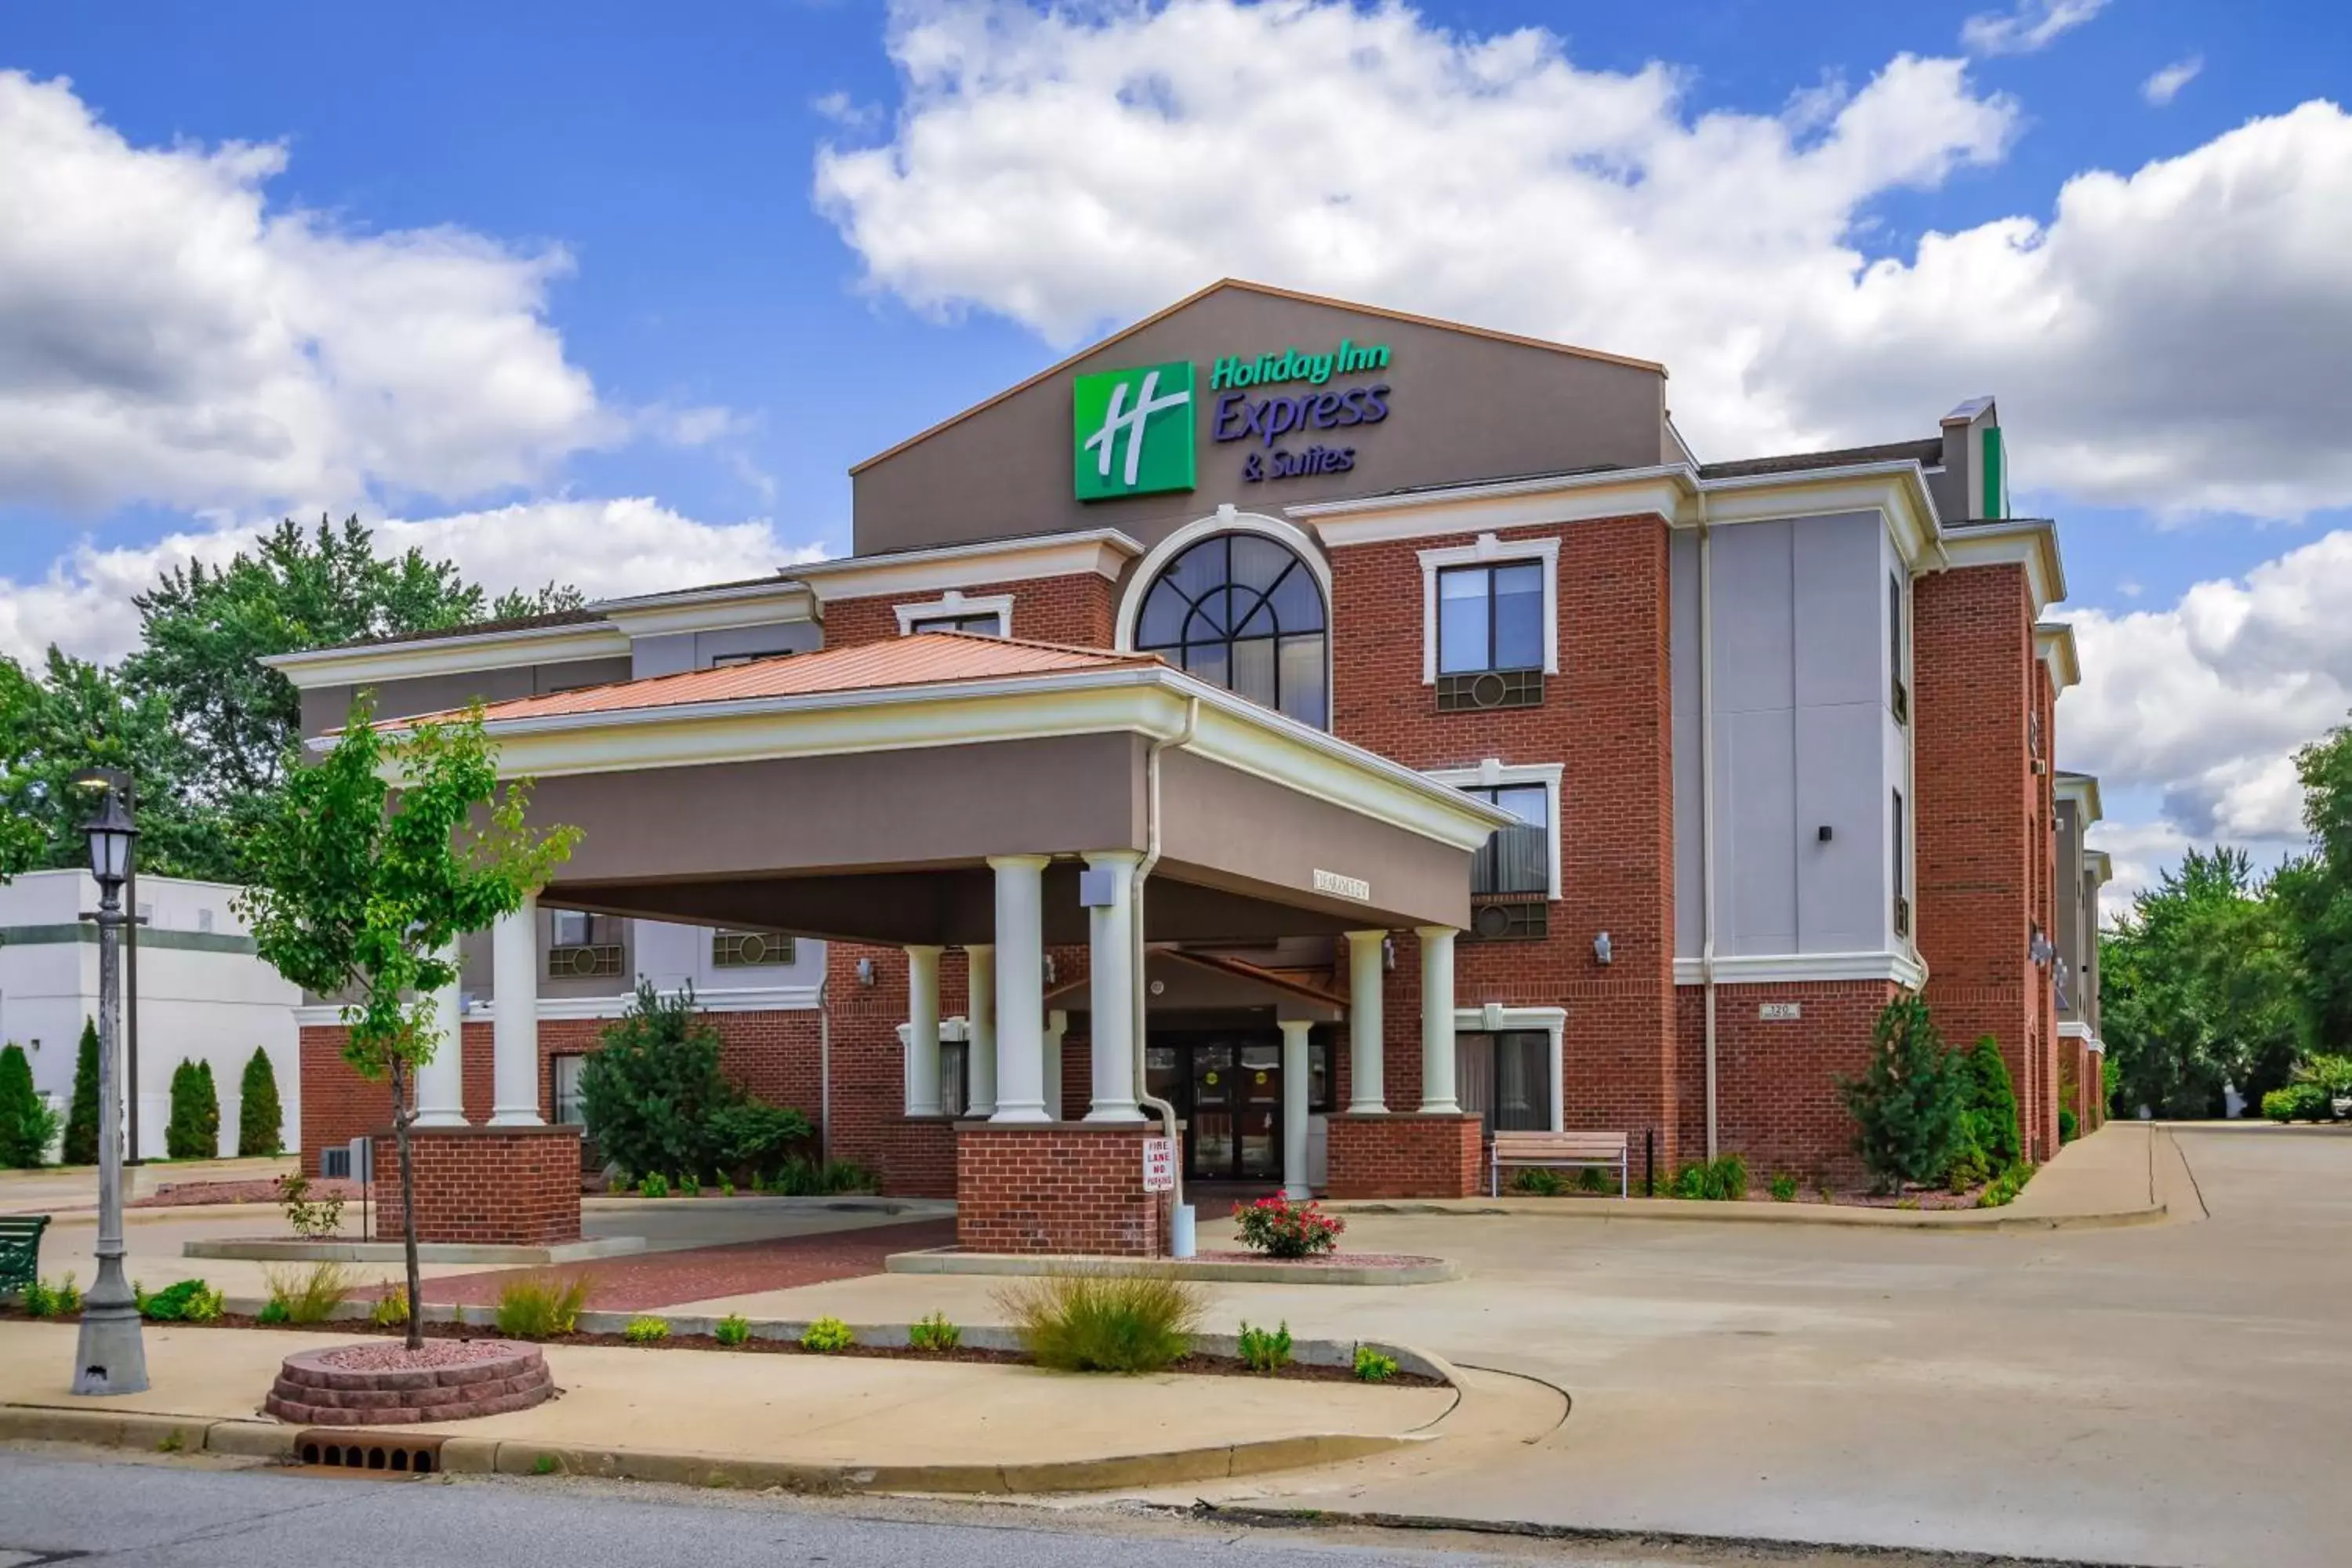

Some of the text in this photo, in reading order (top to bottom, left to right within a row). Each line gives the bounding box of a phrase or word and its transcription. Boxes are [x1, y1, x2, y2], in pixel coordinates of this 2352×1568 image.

[1211, 339, 1390, 390] Holiday Inn
[1084, 371, 1190, 485] H
[1214, 383, 1390, 448] Express
[1243, 444, 1356, 483] & Suites
[1149, 1142, 1169, 1150] FIRE
